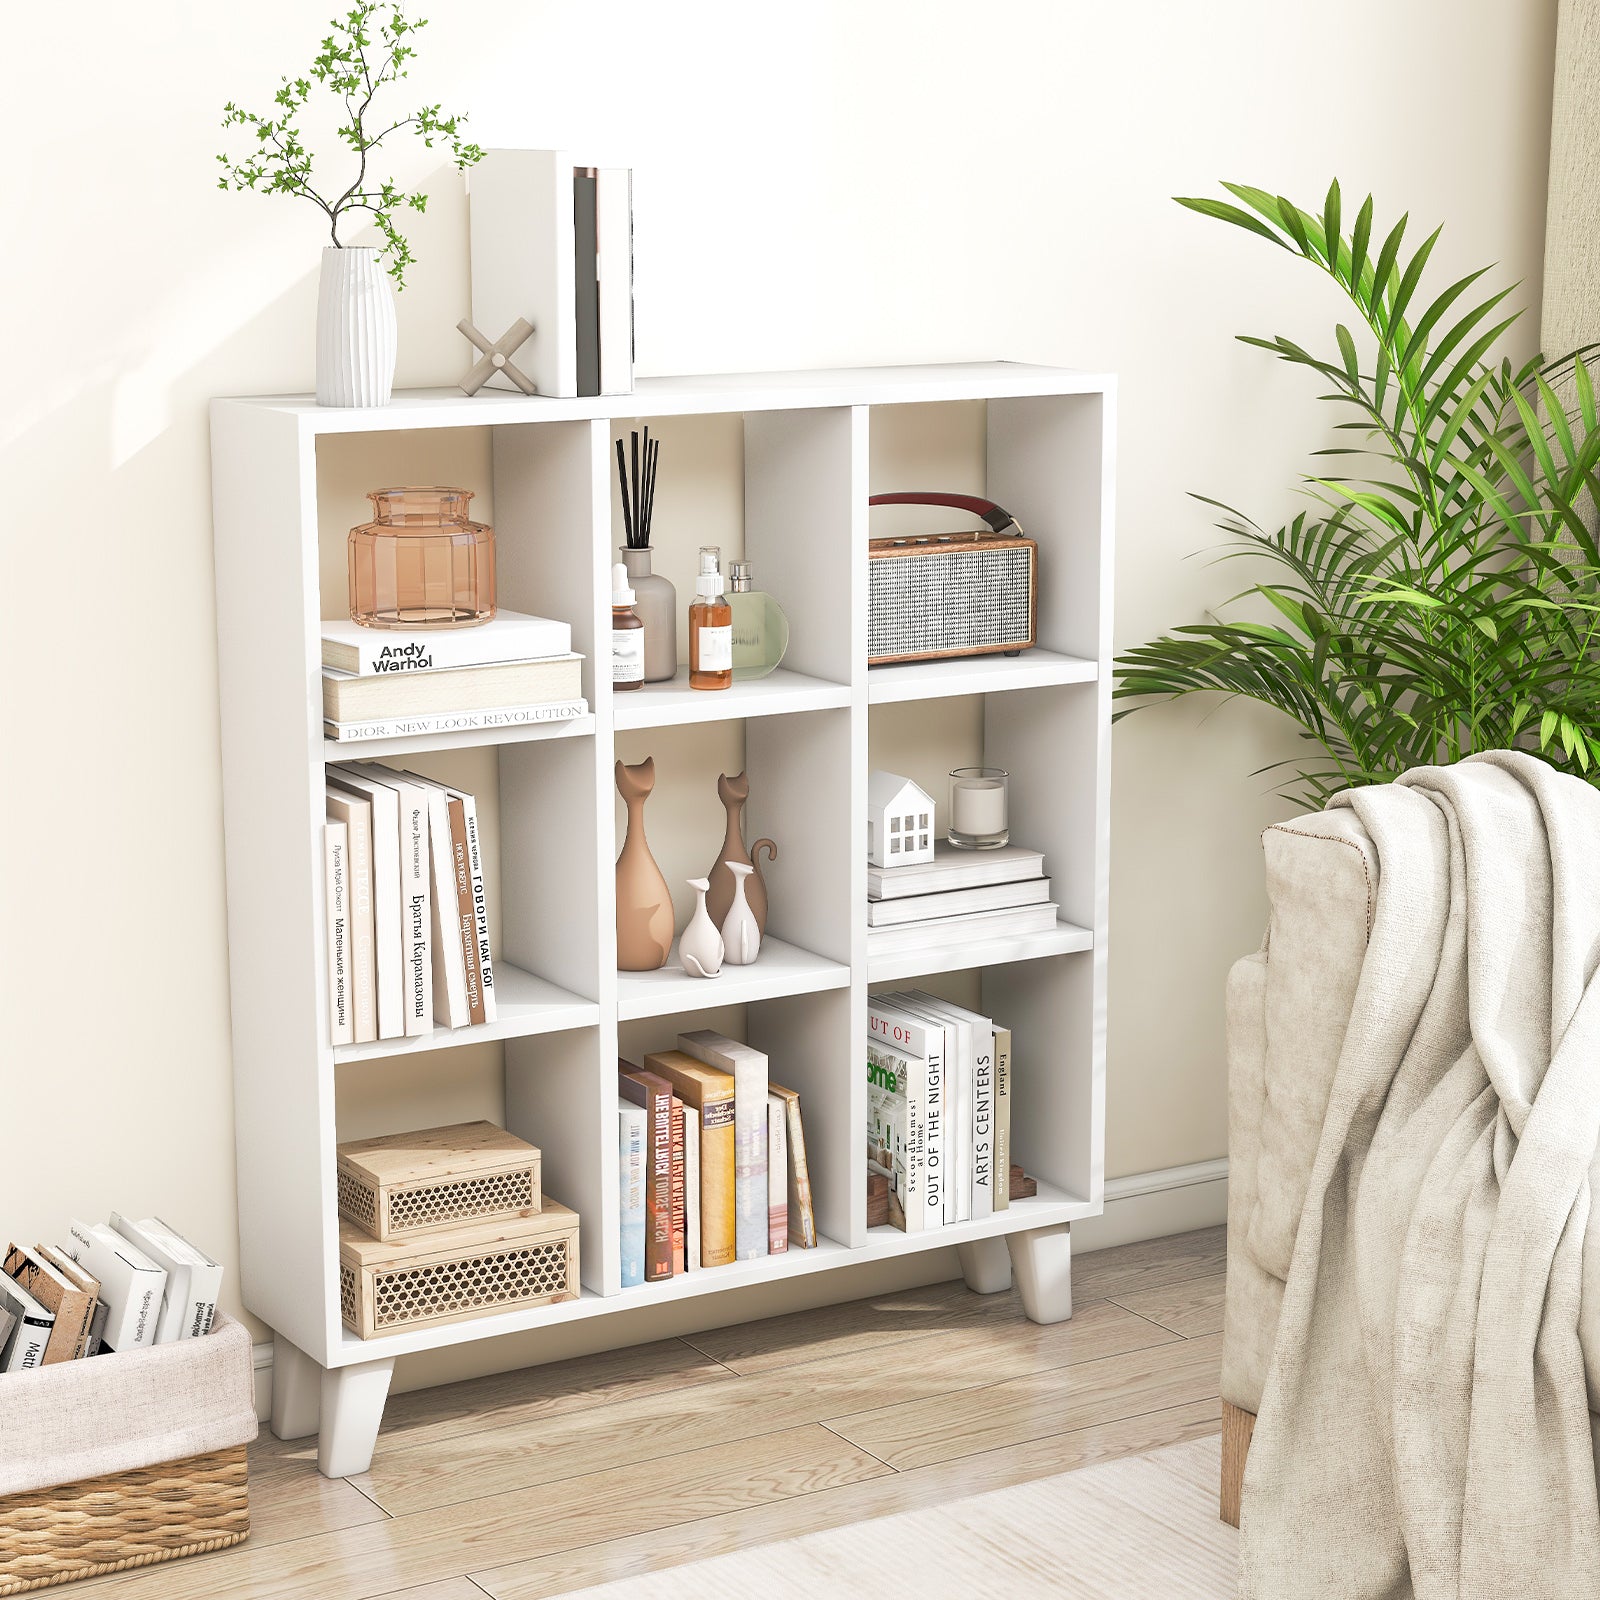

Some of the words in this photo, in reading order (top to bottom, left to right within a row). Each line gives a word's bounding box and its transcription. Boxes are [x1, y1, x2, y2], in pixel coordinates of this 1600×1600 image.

[372, 655, 432, 672] Warhol
[380, 643, 425, 659] Andy
[395, 722, 430, 735] NEW
[436, 717, 479, 730] LOOK
[483, 706, 583, 726] REVOLUTION
[468, 816, 477, 843] КСЕНИЯ
[409, 894, 425, 939] Братья
[472, 876, 488, 934] ГОВОРИ
[335, 918, 345, 975] Маленькие
[461, 913, 475, 970] Бархатная
[479, 939, 491, 963] КАК
[410, 941, 426, 1018] Карамазовы
[467, 971, 479, 1008] смерть
[482, 967, 493, 989] БОГ
[337, 977, 345, 1026] женщины
[893, 1026, 912, 1045] OF
[928, 1054, 940, 1108] NIGHT
[998, 1054, 1007, 1096] England
[976, 1055, 990, 1135] CENTERS
[928, 1110, 940, 1141] THE
[908, 1099, 917, 1192] Secondhomes!
[917, 1156, 924, 1167] at
[928, 1147, 939, 1168] OF
[975, 1142, 989, 1186] ARTS
[928, 1174, 939, 1206] OUT
